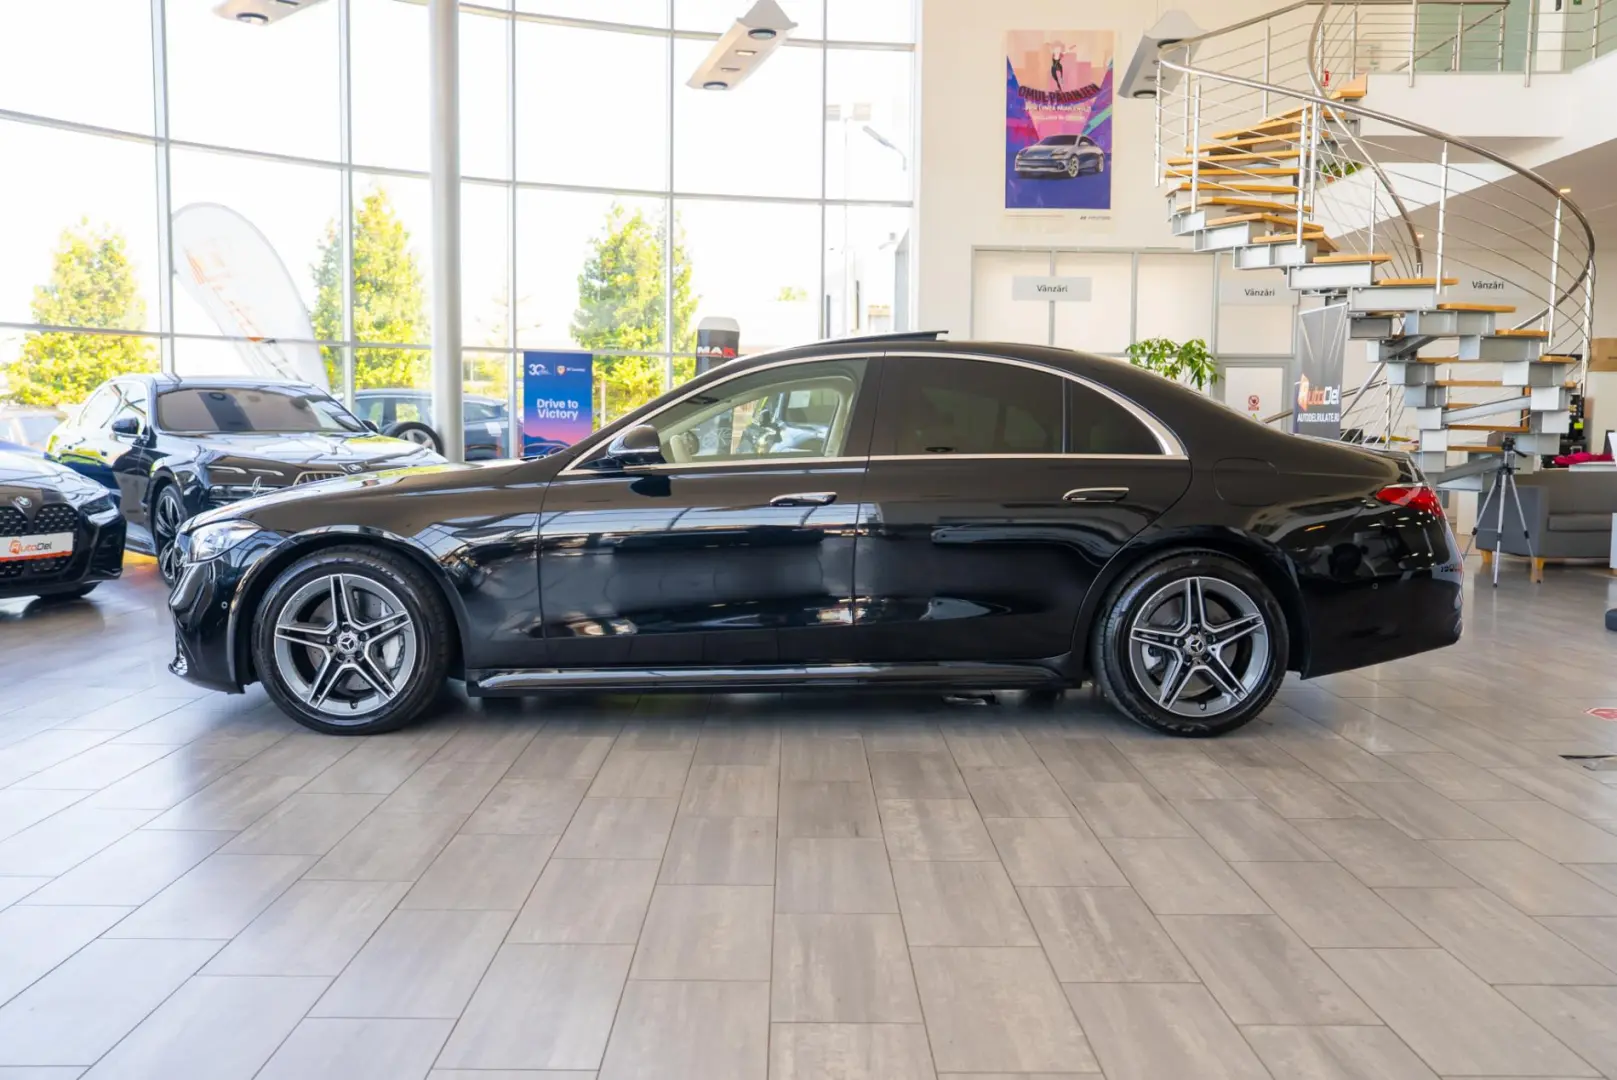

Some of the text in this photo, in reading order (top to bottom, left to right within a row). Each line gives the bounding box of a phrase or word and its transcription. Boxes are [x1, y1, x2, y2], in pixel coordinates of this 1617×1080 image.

[1036, 284, 1068, 293] Vânzări
[1472, 280, 1504, 289] Vânzări
[1244, 288, 1275, 297] Vânzări
[537, 398, 579, 409] Drive to
[537, 409, 579, 421] Victory
